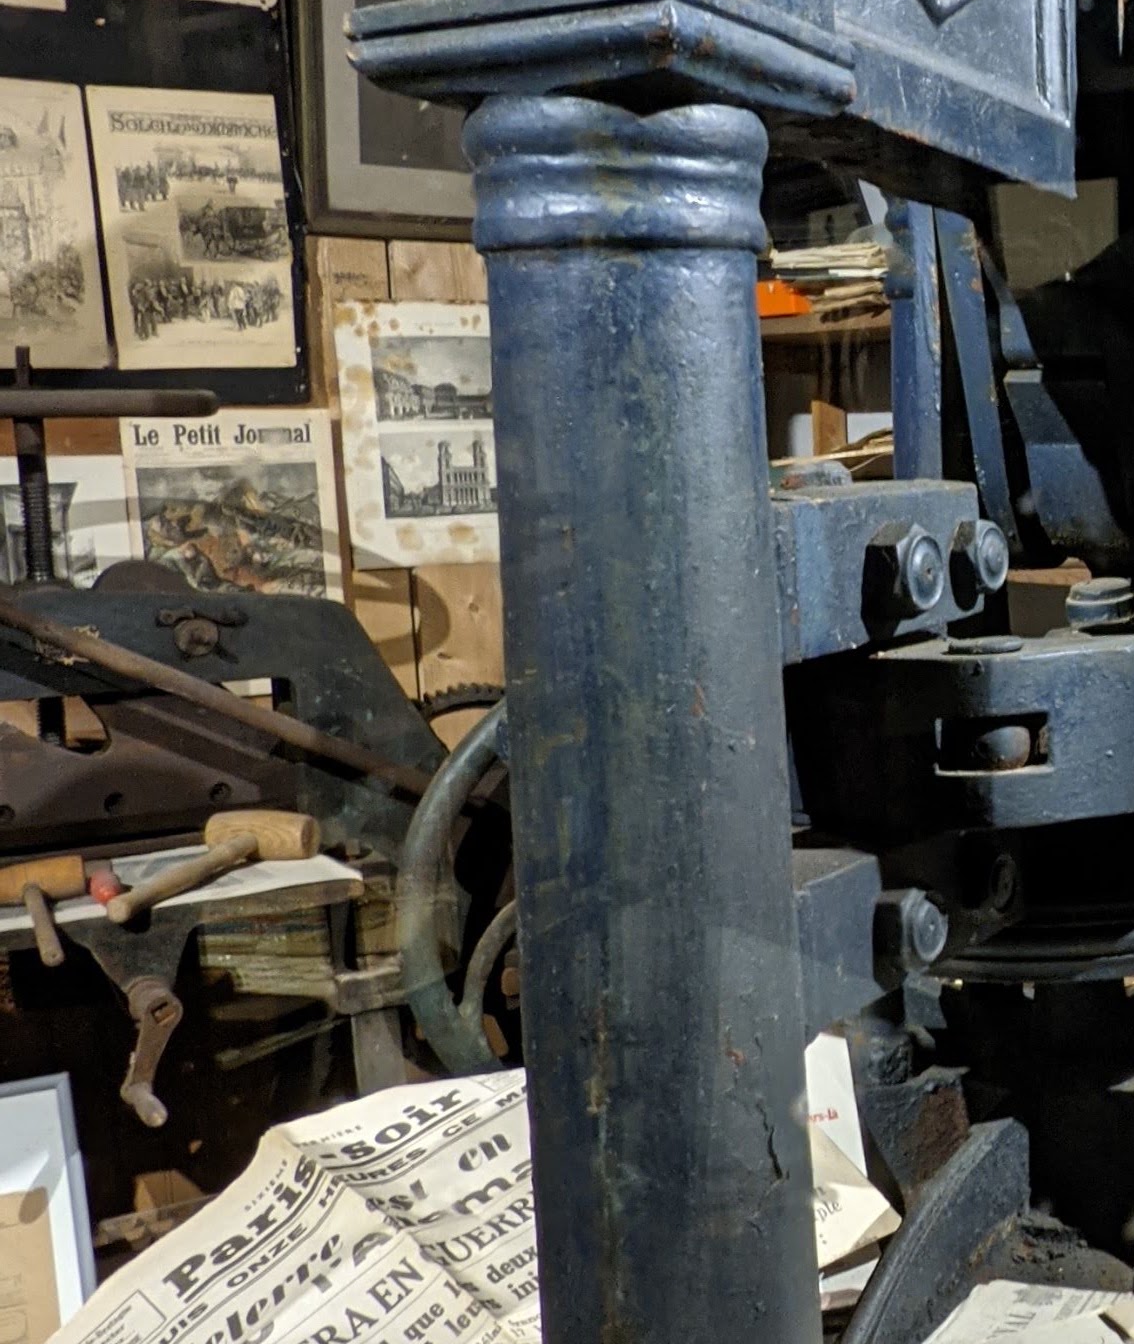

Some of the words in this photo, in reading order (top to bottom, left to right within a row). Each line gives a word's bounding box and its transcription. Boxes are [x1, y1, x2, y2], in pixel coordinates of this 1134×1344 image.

[133, 424, 160, 446] Le
[173, 423, 221, 445] Petit
[234, 423, 311, 444] Joal
[227, 1223, 308, 1288] ONZE
[442, 1112, 482, 1139] CE
[458, 1133, 512, 1172] en
[366, 1256, 425, 1314] EN
[420, 1193, 535, 1267] GUERR
[403, 1303, 445, 1344] que
[486, 1245, 538, 1284] deux
